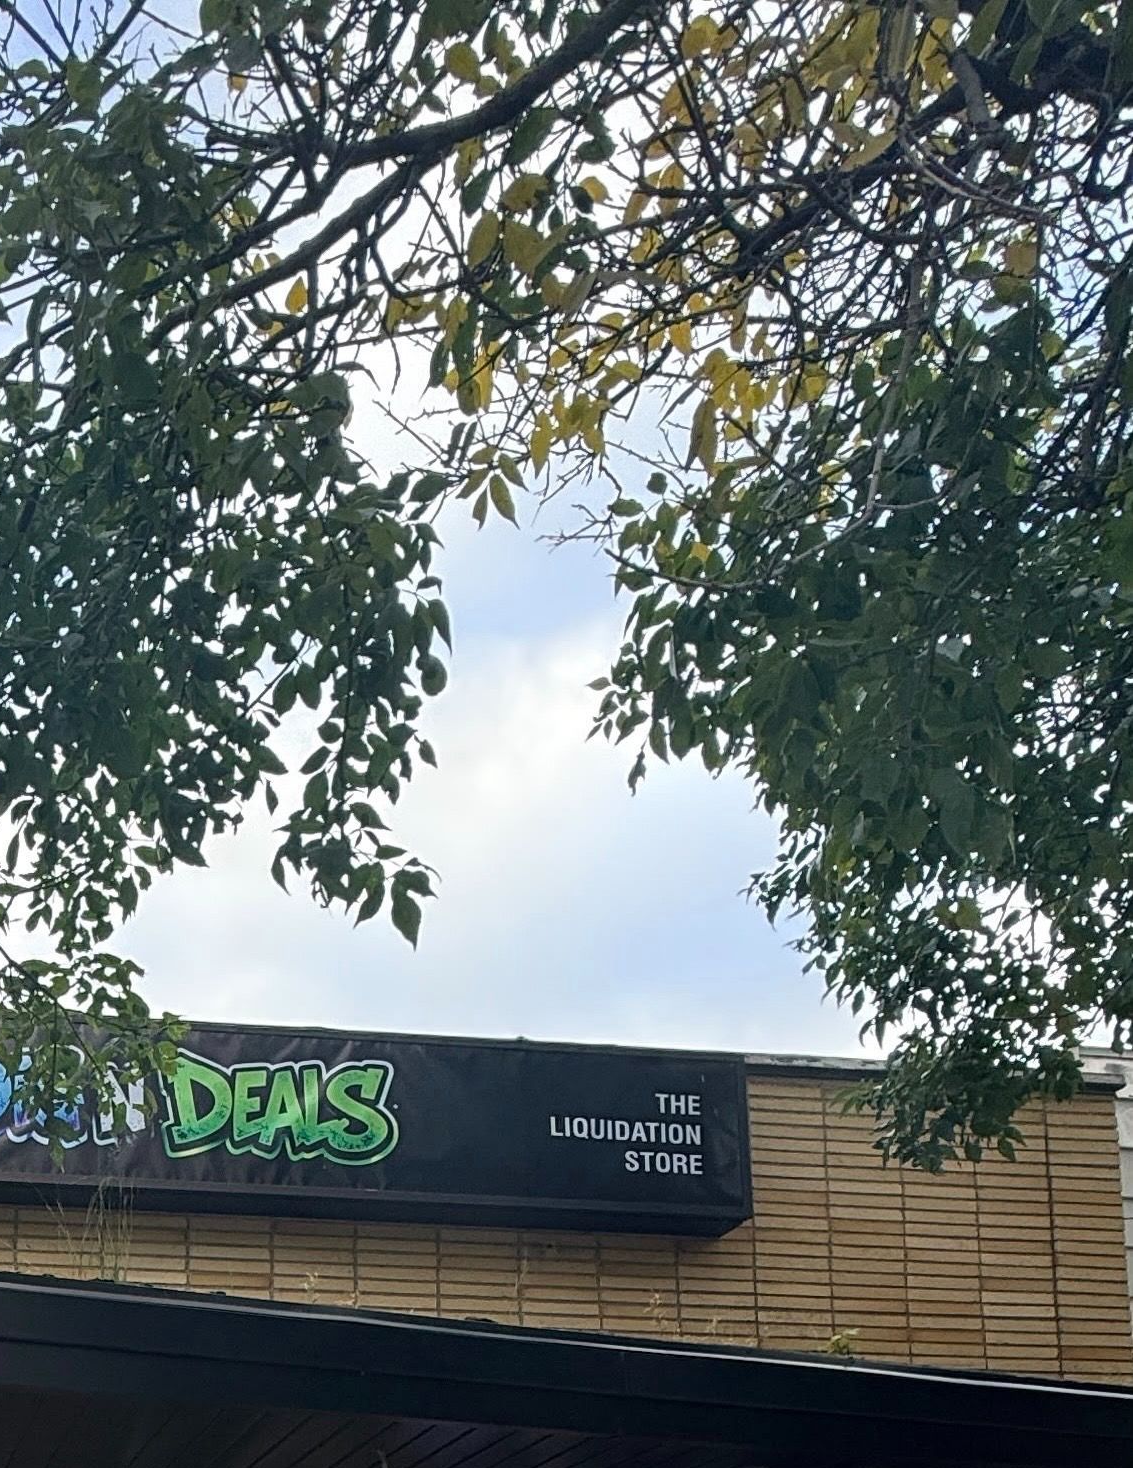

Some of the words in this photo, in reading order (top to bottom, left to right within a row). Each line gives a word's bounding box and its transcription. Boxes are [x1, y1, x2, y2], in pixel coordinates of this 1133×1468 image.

[655, 1092, 701, 1116] THE
[549, 1116, 702, 1146] LIQUIDATION
[624, 1150, 704, 1175] STORE
